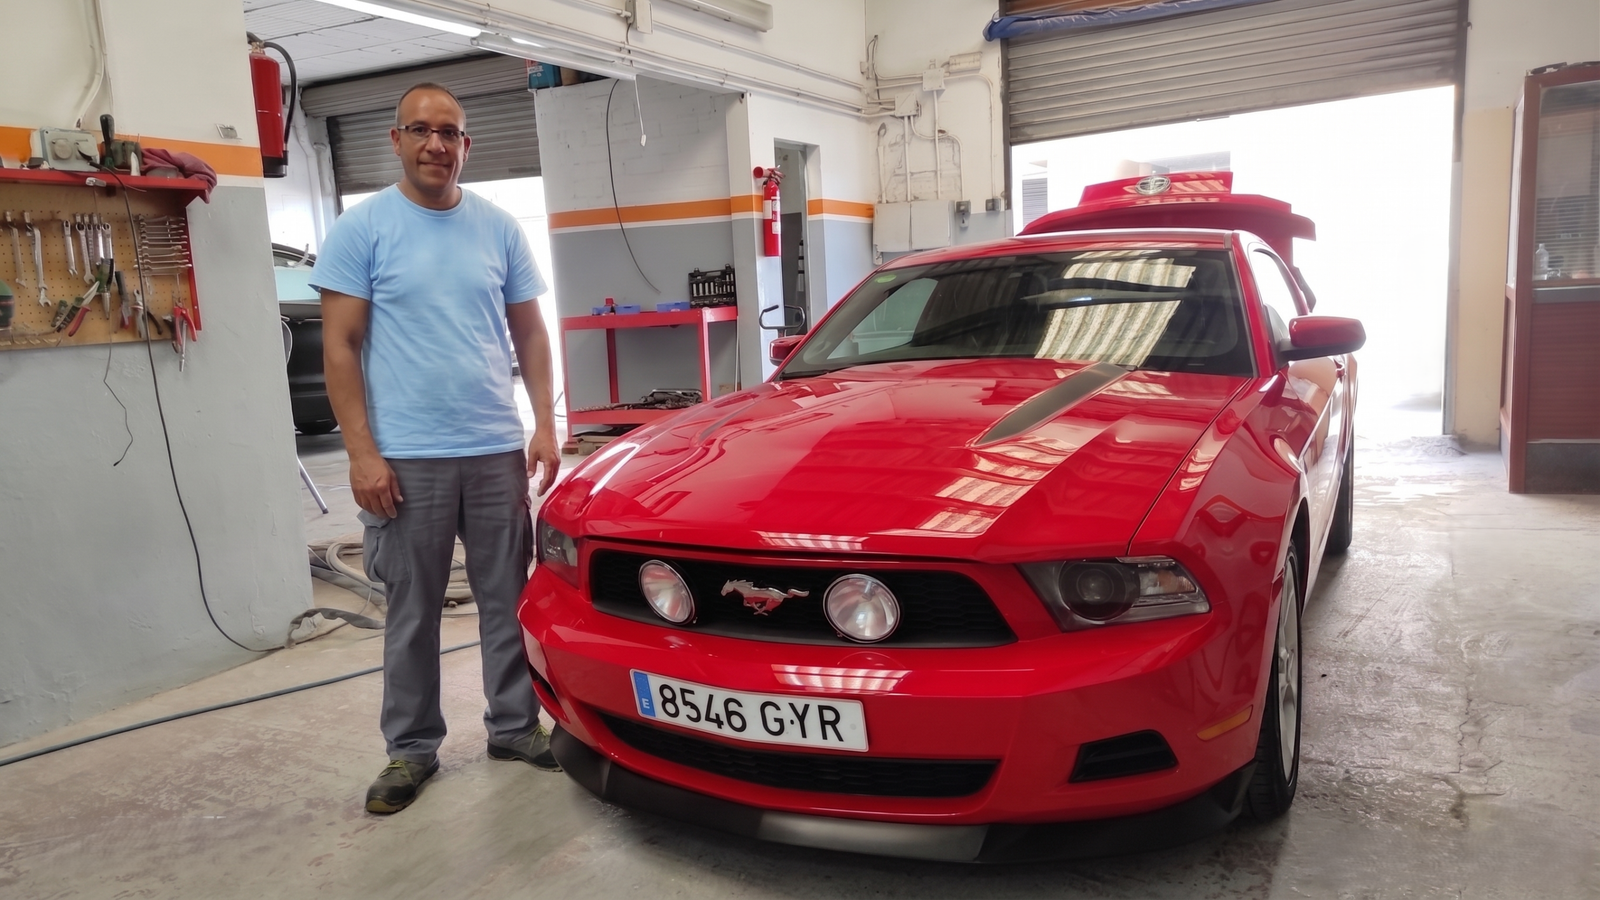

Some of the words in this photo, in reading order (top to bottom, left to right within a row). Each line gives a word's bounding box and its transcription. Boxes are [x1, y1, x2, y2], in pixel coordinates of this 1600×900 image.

[641, 698, 650, 709] E
[659, 684, 747, 733] 8546
[760, 701, 844, 742] GYR
